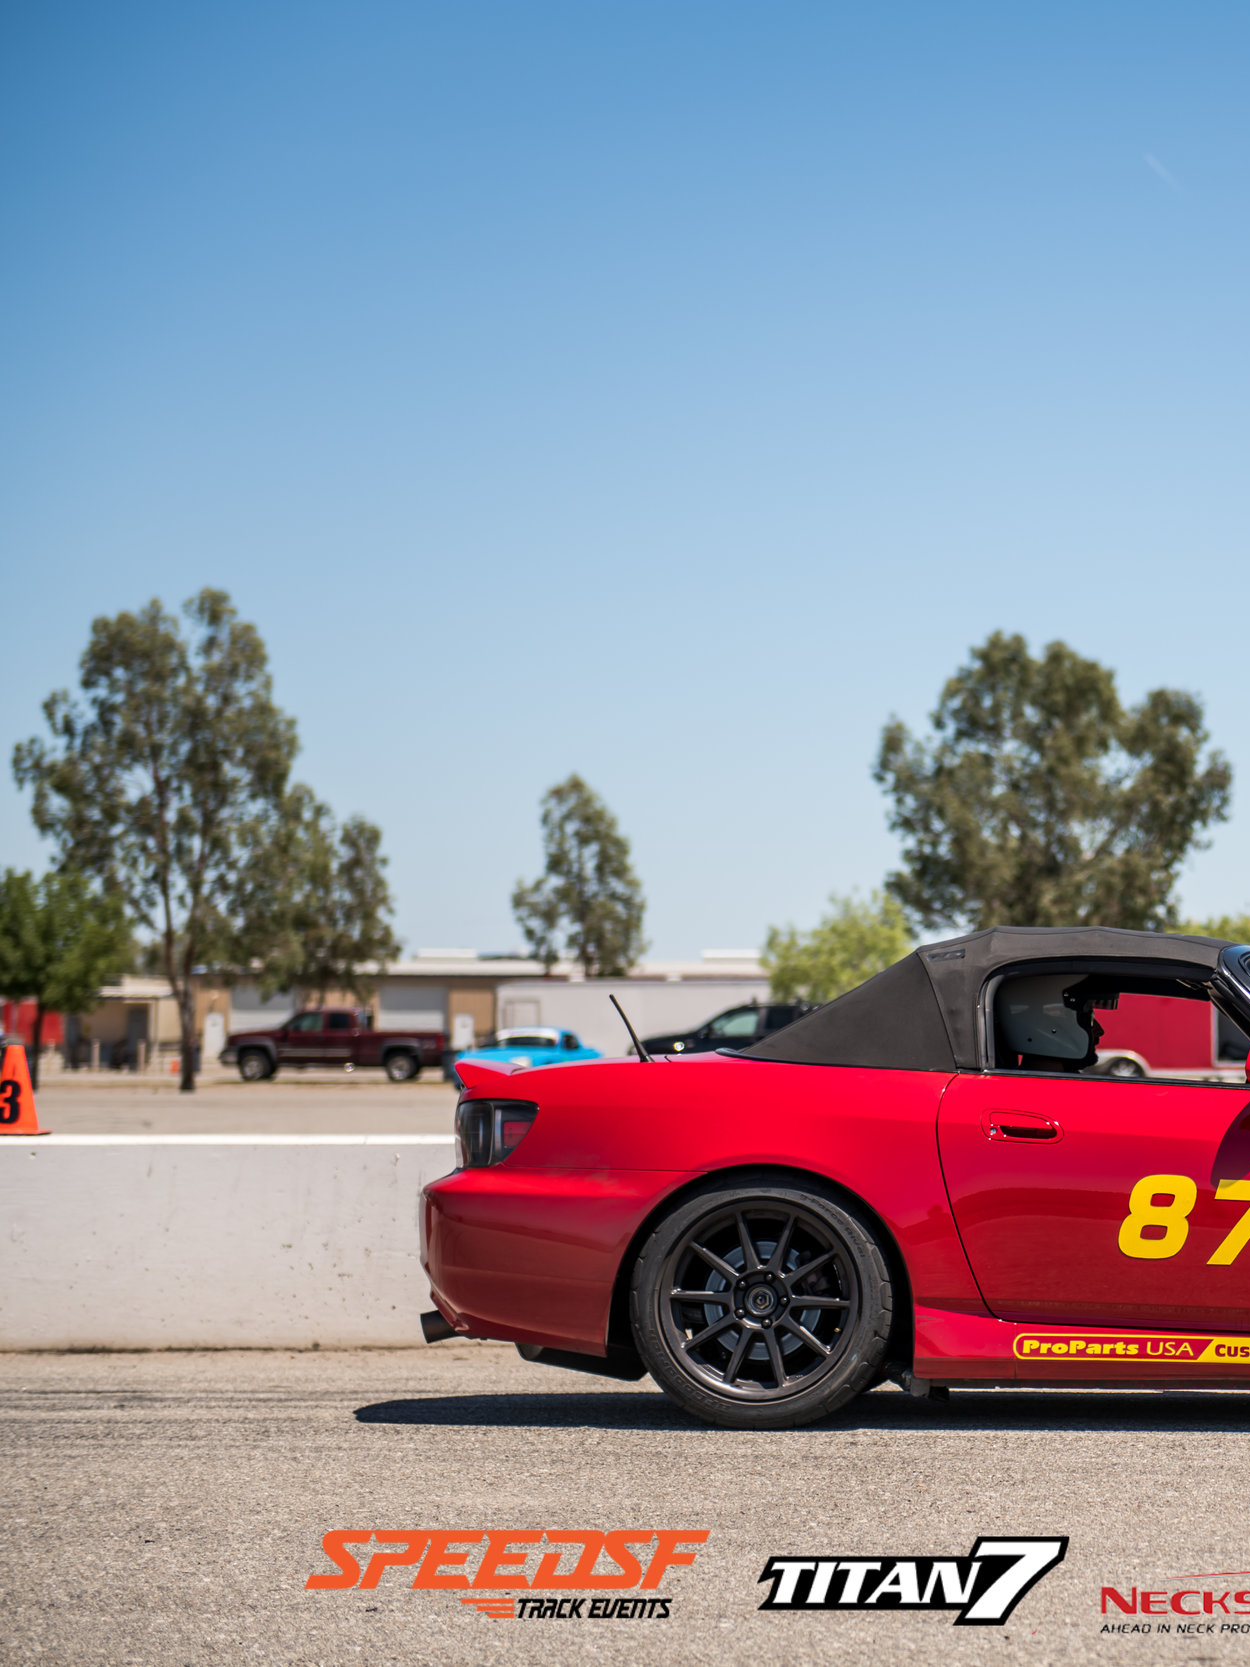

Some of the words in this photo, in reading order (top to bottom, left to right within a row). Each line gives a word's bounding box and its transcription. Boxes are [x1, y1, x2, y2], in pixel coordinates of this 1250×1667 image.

[0, 1080, 20, 1124] 3
[1022, 1339, 1139, 1356] ProParts
[1146, 1340, 1194, 1357] USA
